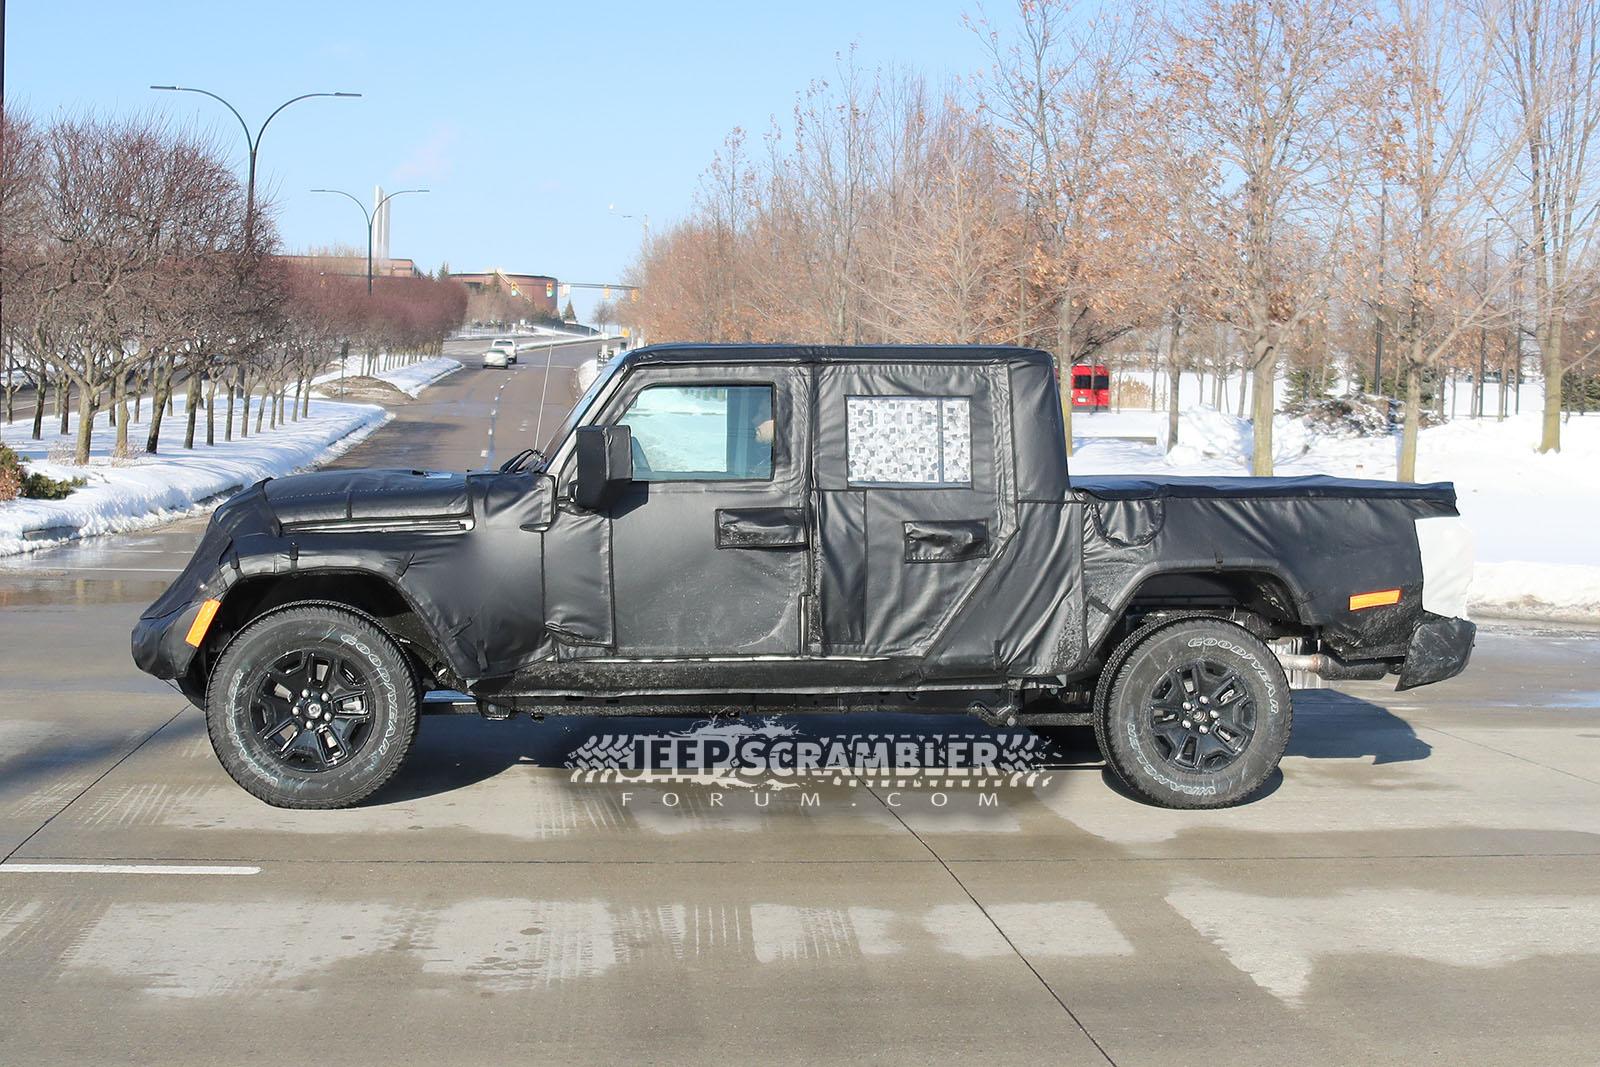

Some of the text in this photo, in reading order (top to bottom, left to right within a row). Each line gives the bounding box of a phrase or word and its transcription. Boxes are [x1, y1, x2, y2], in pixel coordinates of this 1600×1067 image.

[341, 634, 397, 755] GOODYEAR
[1188, 638, 1279, 713] GOODYEAR
[1127, 723, 1217, 795] WRANGLER
